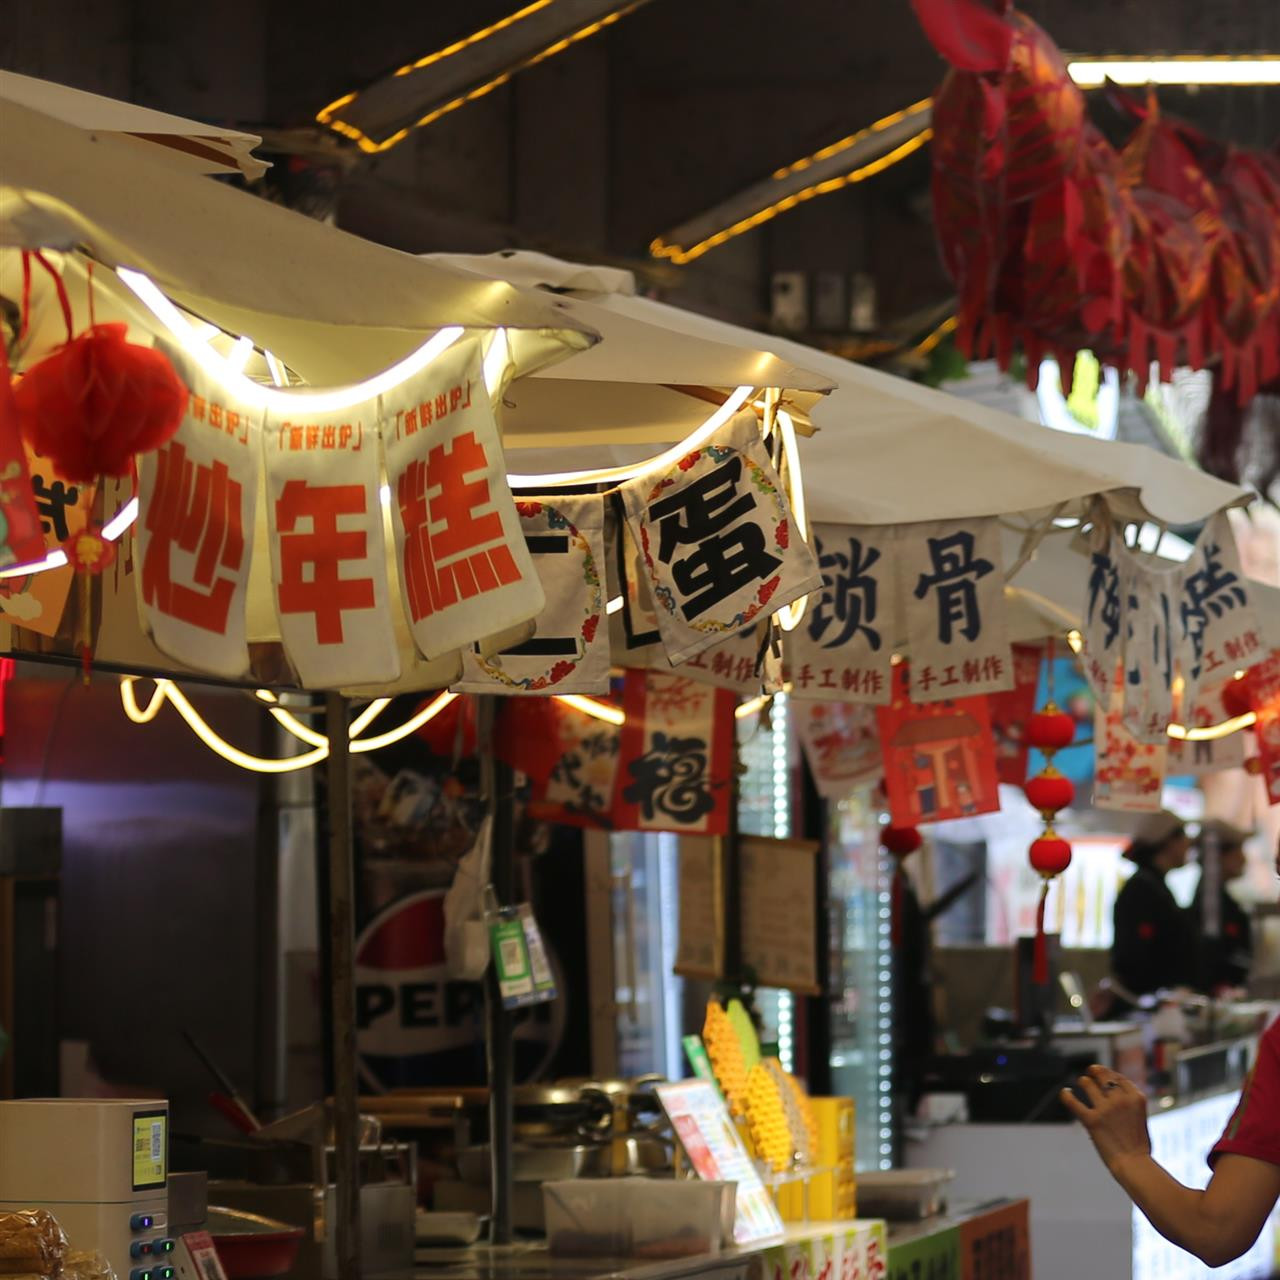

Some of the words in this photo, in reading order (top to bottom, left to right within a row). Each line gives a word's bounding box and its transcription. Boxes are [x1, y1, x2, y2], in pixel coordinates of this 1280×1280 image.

[686, 651, 755, 682] 工制作
[1204, 630, 1260, 673] 工制作
[797, 663, 884, 694] 手工制作
[918, 656, 1004, 691] 手工制作
